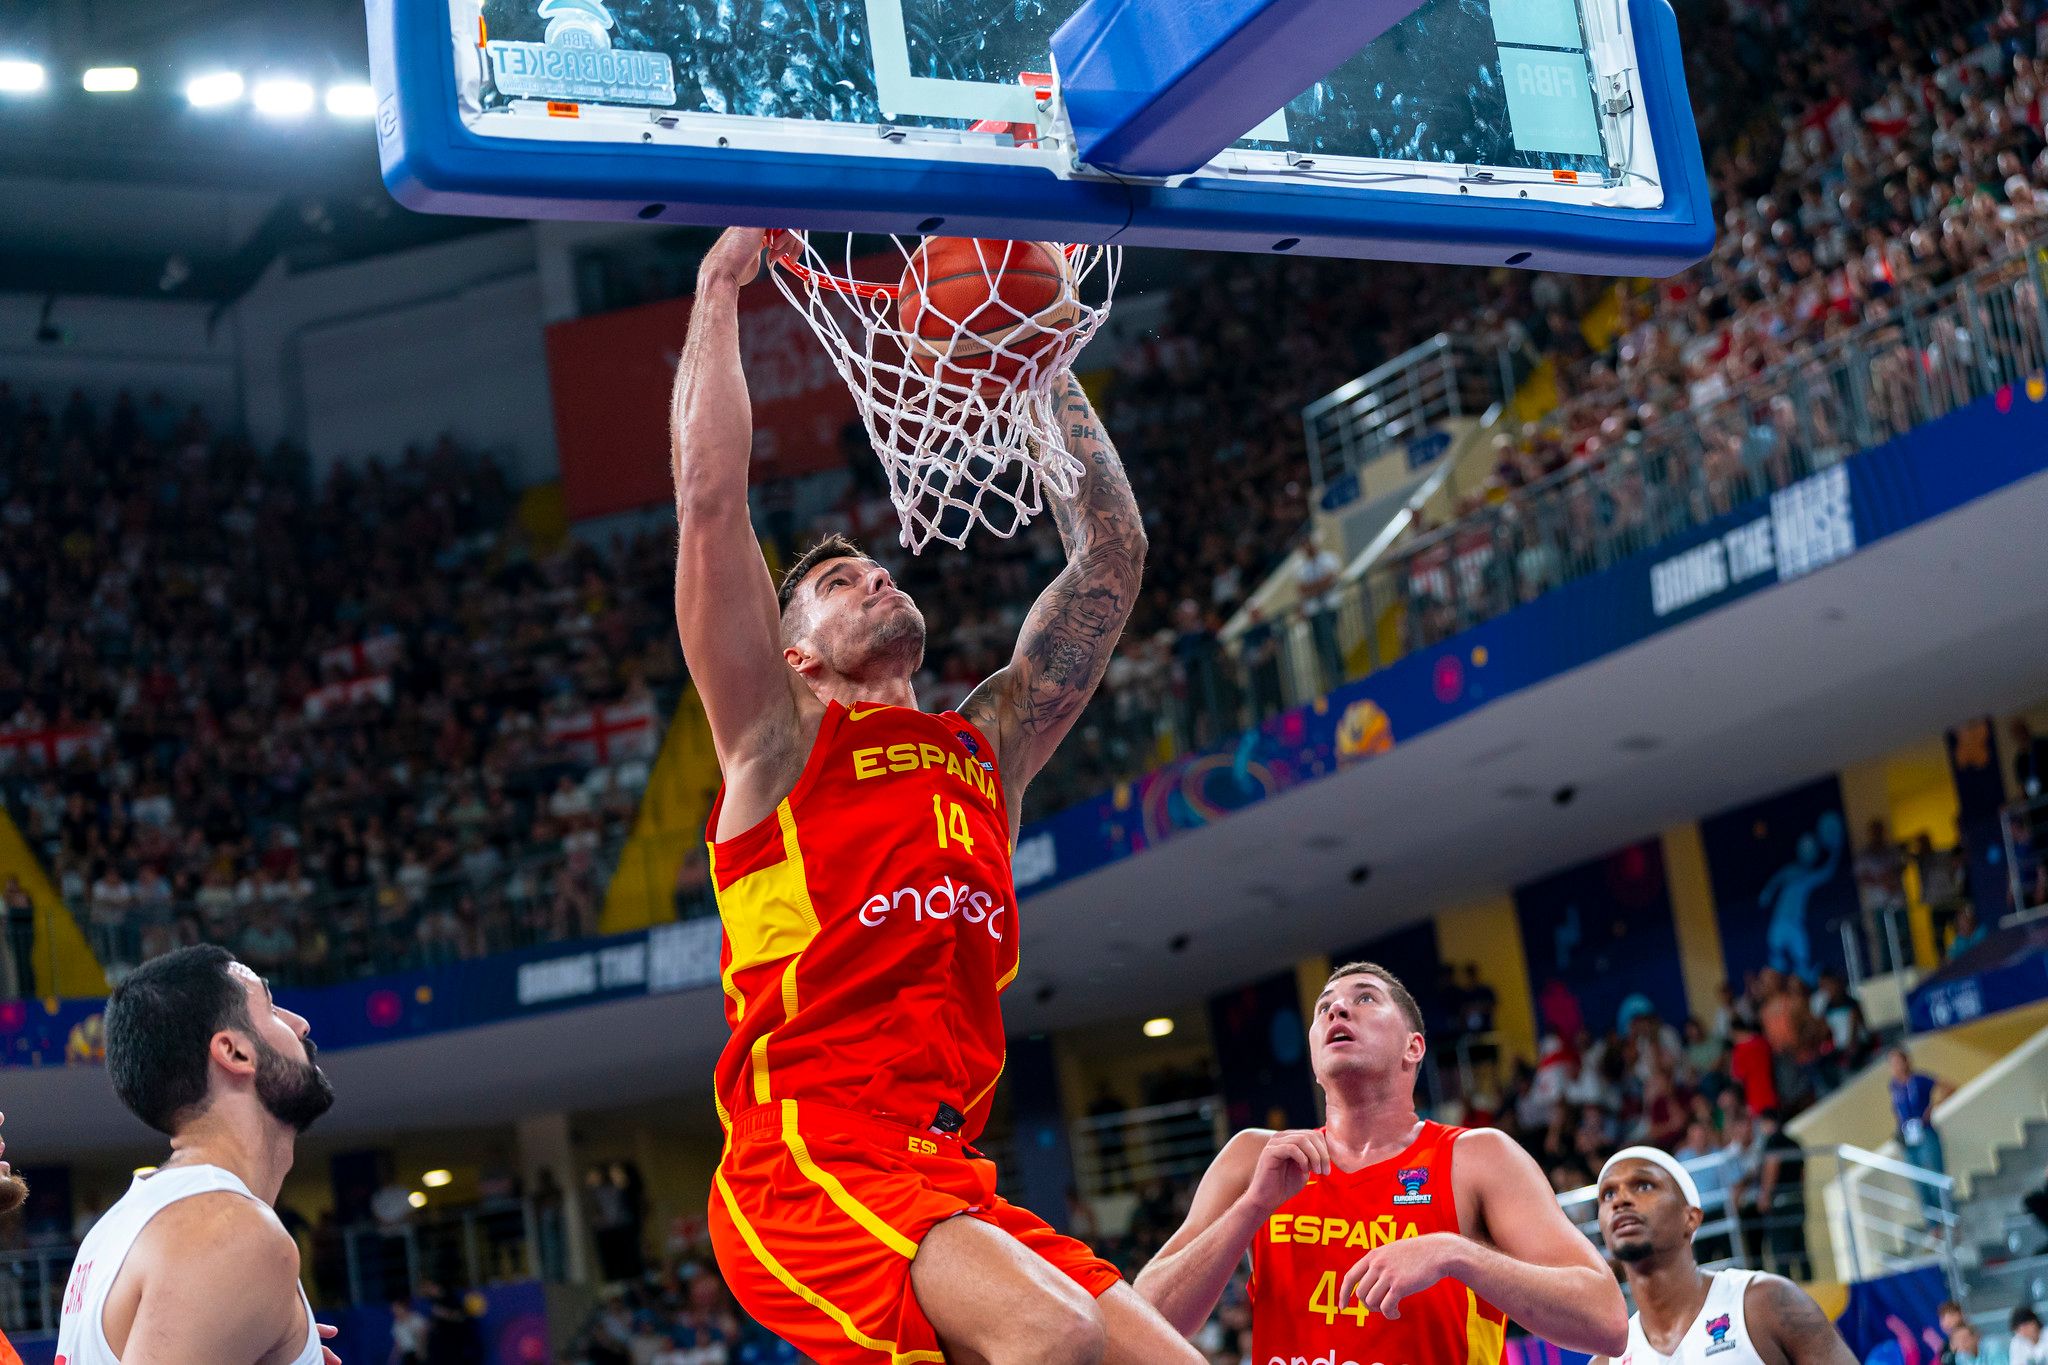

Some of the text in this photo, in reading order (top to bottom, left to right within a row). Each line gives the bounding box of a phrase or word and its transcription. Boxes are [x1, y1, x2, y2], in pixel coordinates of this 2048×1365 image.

[852, 743, 996, 810] ESPAÑA
[932, 793, 974, 856] 14
[907, 1135, 938, 1156] ESP
[1269, 1214, 1419, 1250] ESPAÑA
